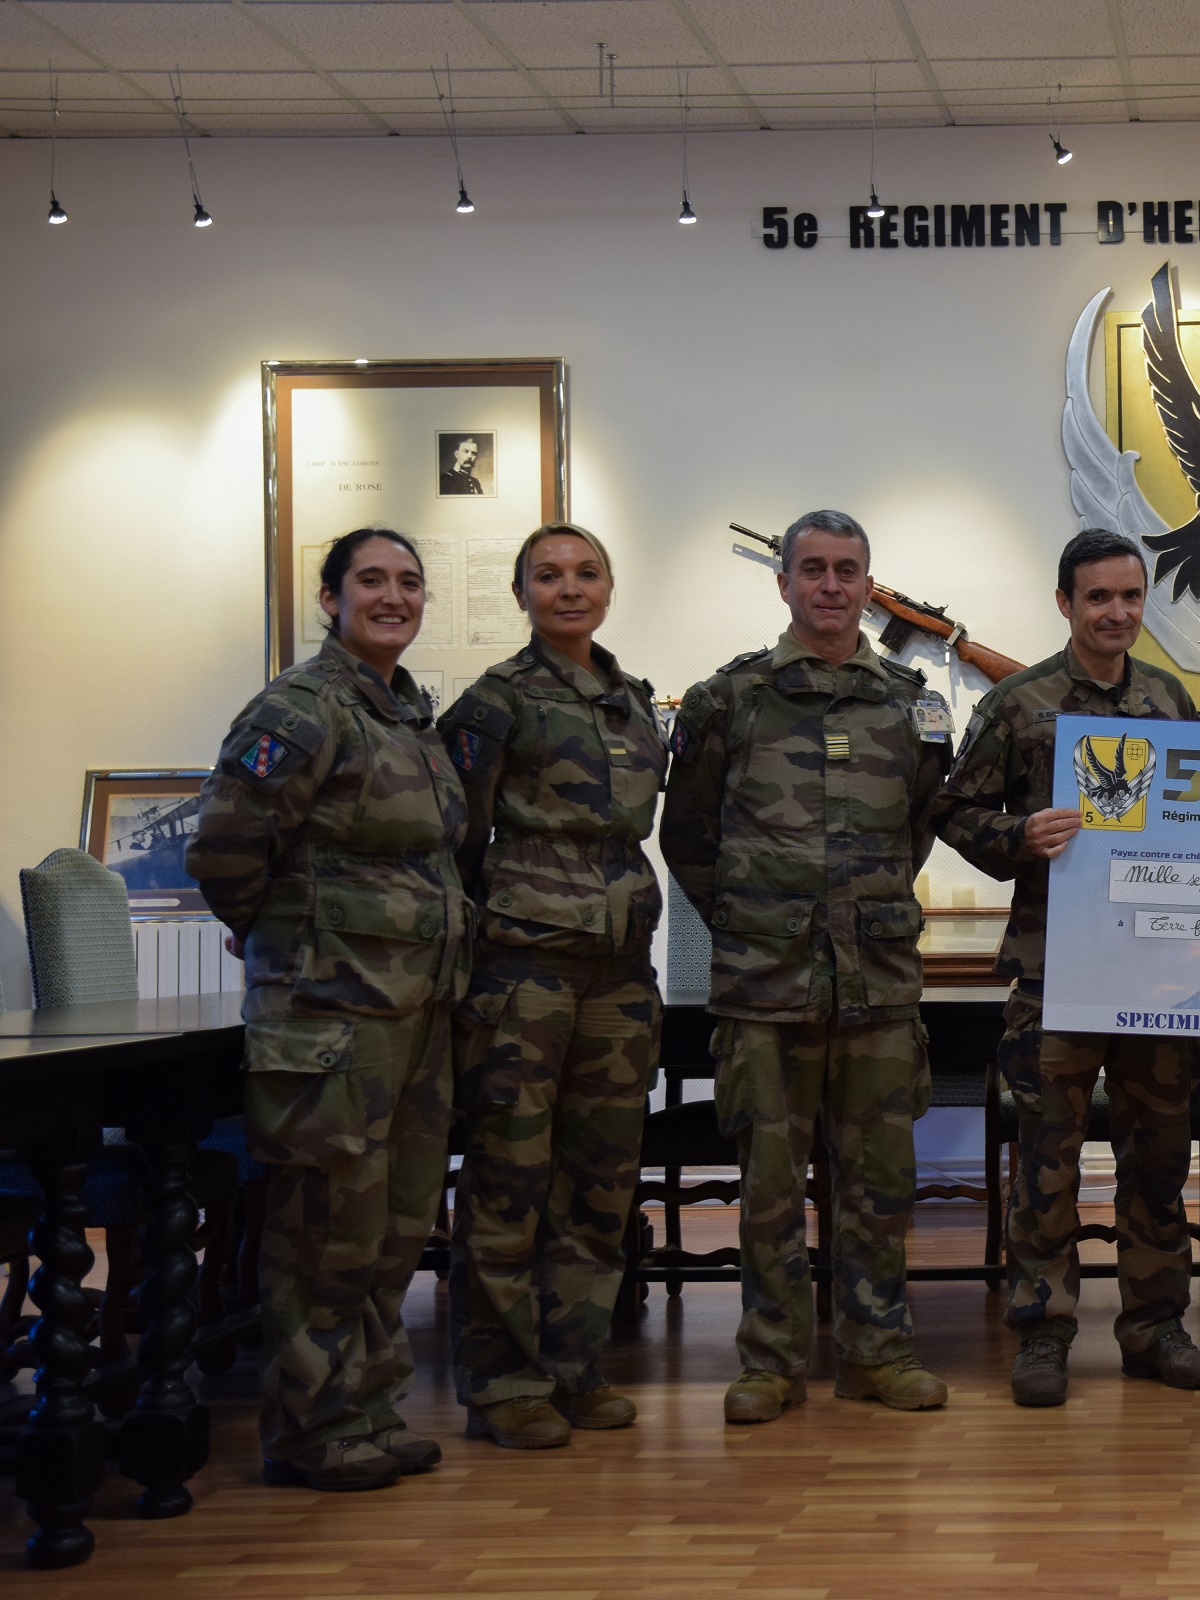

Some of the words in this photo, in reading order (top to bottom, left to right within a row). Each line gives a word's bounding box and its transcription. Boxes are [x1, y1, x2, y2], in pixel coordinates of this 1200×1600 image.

[762, 206, 818, 249] 5e
[850, 203, 1067, 249] REGIMENT
[1085, 812, 1094, 824] 5
[1111, 849, 1138, 859] Payez
[1125, 865, 1180, 884] Mille
[1149, 916, 1187, 932] Terre
